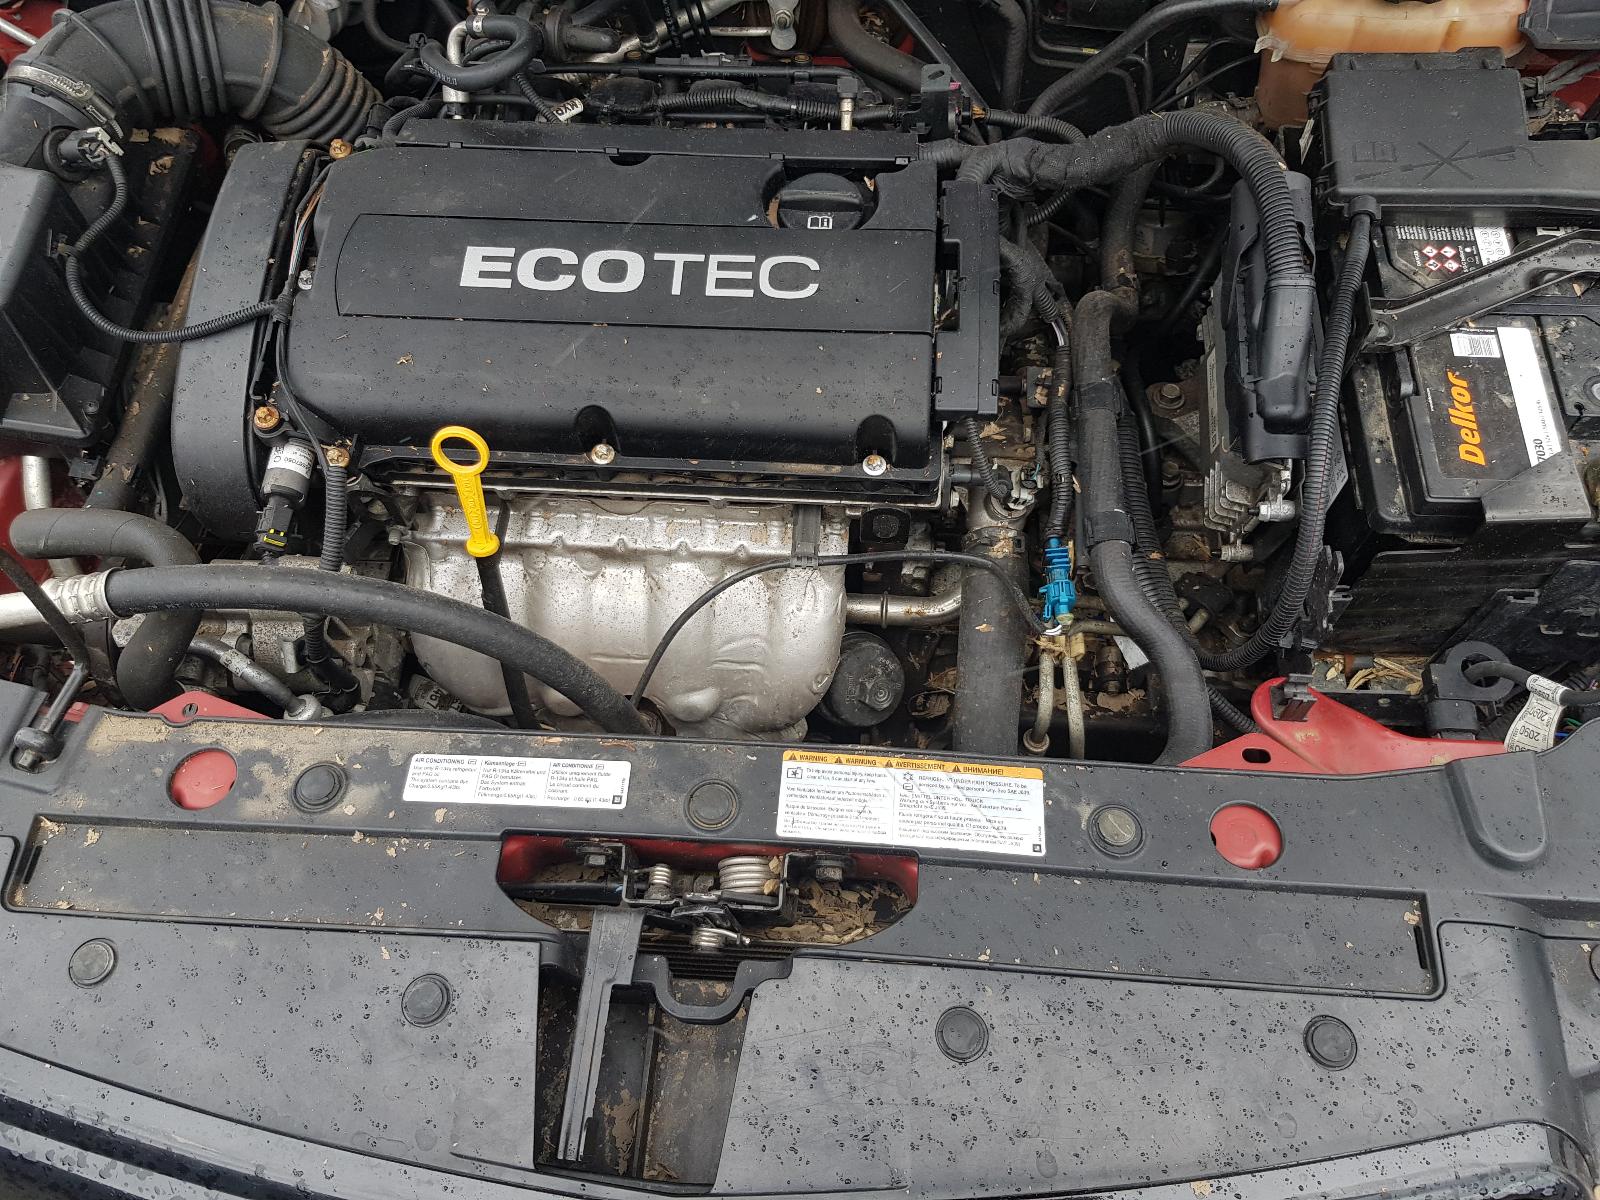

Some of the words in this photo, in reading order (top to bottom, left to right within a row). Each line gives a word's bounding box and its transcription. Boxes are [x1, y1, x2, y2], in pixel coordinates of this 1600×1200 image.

[460, 245, 821, 300] ECOTEC
[1446, 368, 1488, 467] Delkor
[1518, 725, 1541, 742] 2090
[426, 757, 465, 765] CONDITIONING
[799, 754, 828, 762] WARNING
[845, 758, 877, 766] WARNUNG
[895, 761, 945, 770] AVERTISSEMENT
[962, 764, 1004, 775] ВНИМАНИЕ!
